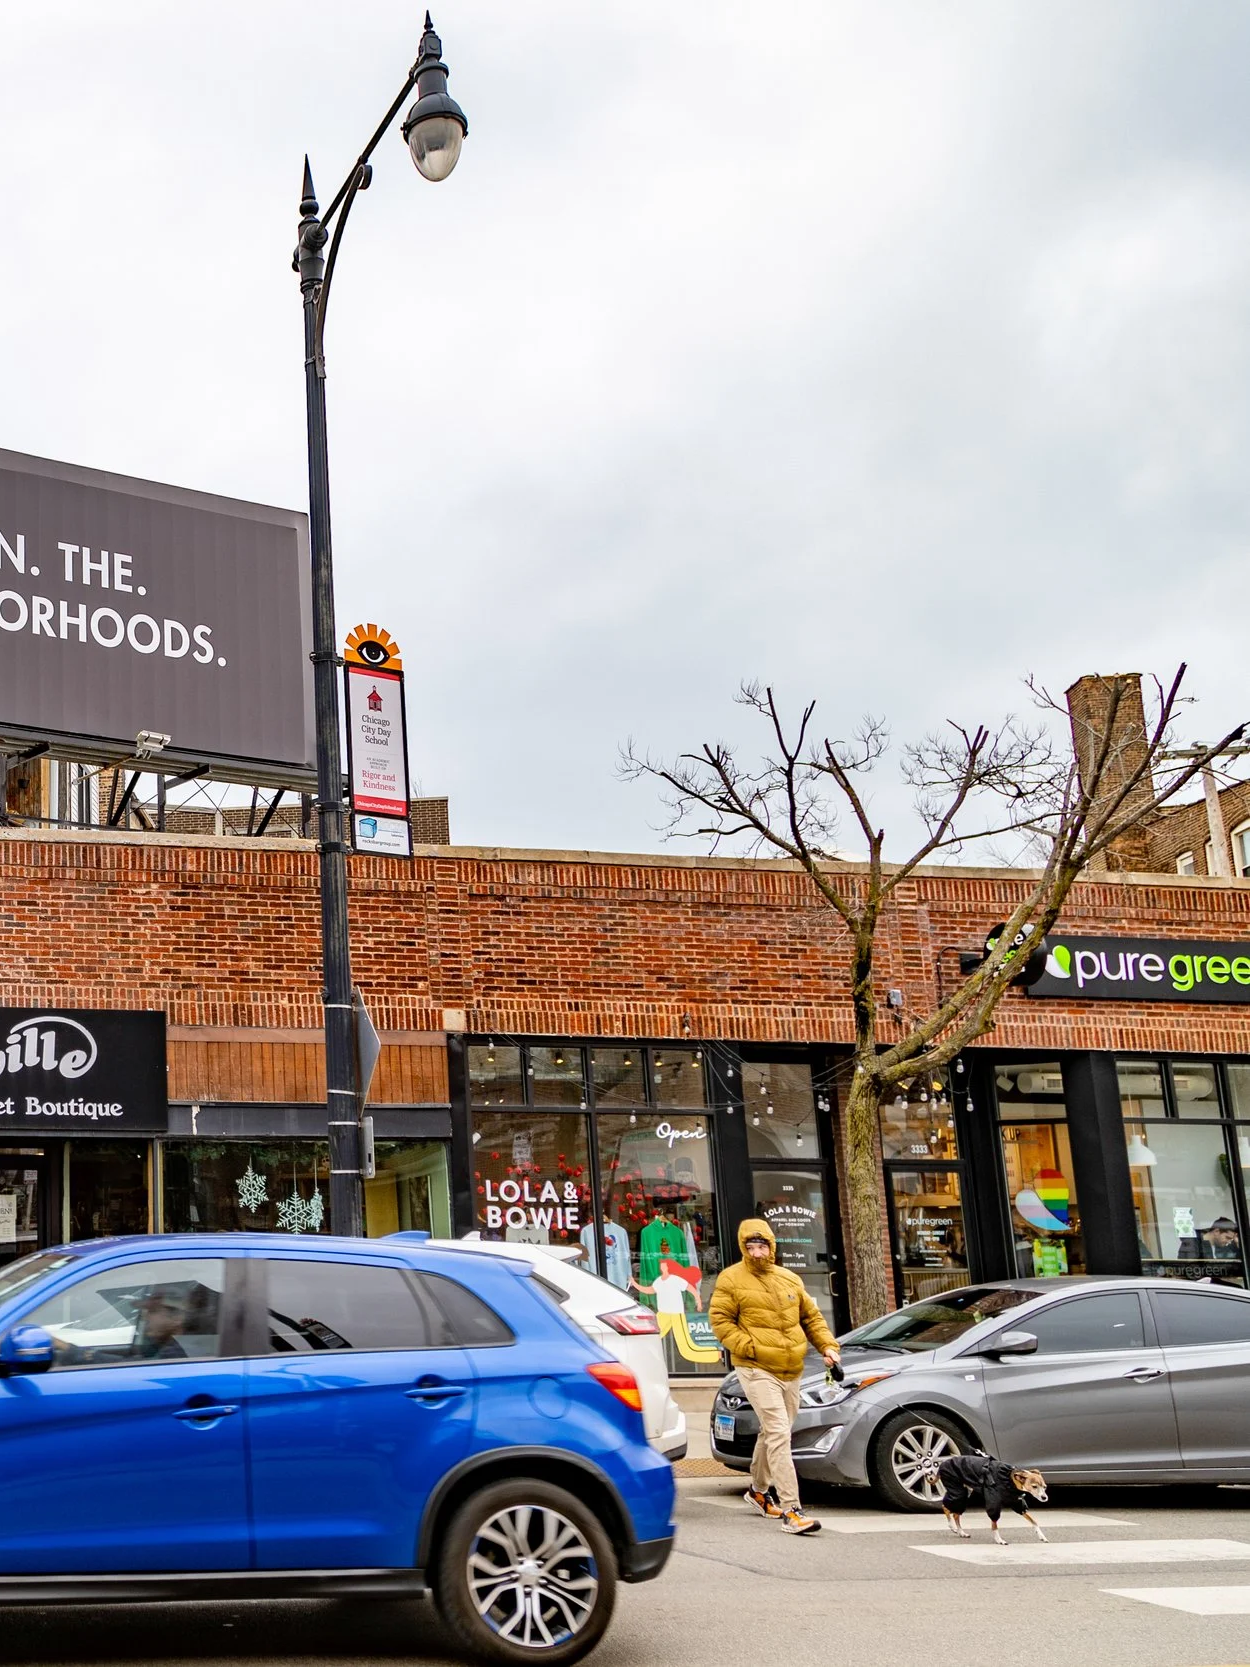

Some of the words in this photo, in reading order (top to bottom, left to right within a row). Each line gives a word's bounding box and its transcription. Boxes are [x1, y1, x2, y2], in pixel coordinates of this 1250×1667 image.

[57, 542, 147, 596] THE.
[361, 714, 390, 727] Chicago
[361, 725, 376, 735] City
[377, 727, 392, 738] Day
[365, 735, 389, 746] School
[362, 770, 381, 780] Rigor
[382, 774, 396, 782] and
[363, 780, 396, 792] Kindness
[1075, 951, 1165, 988] pure
[1168, 954, 1250, 991] gree
[25, 1096, 124, 1120] Boutique
[656, 1122, 707, 1148] Open
[911, 1145, 928, 1154] 3333
[485, 1179, 560, 1203] LOLA
[563, 1181, 579, 1203] &
[487, 1206, 580, 1230] BOWIE
[763, 1206, 784, 1219] LOLA
[785, 1205, 791, 1213] &
[792, 1205, 817, 1219] BOWIE
[911, 1218, 953, 1227] puregreen
[1165, 1265, 1228, 1278] puregreen
